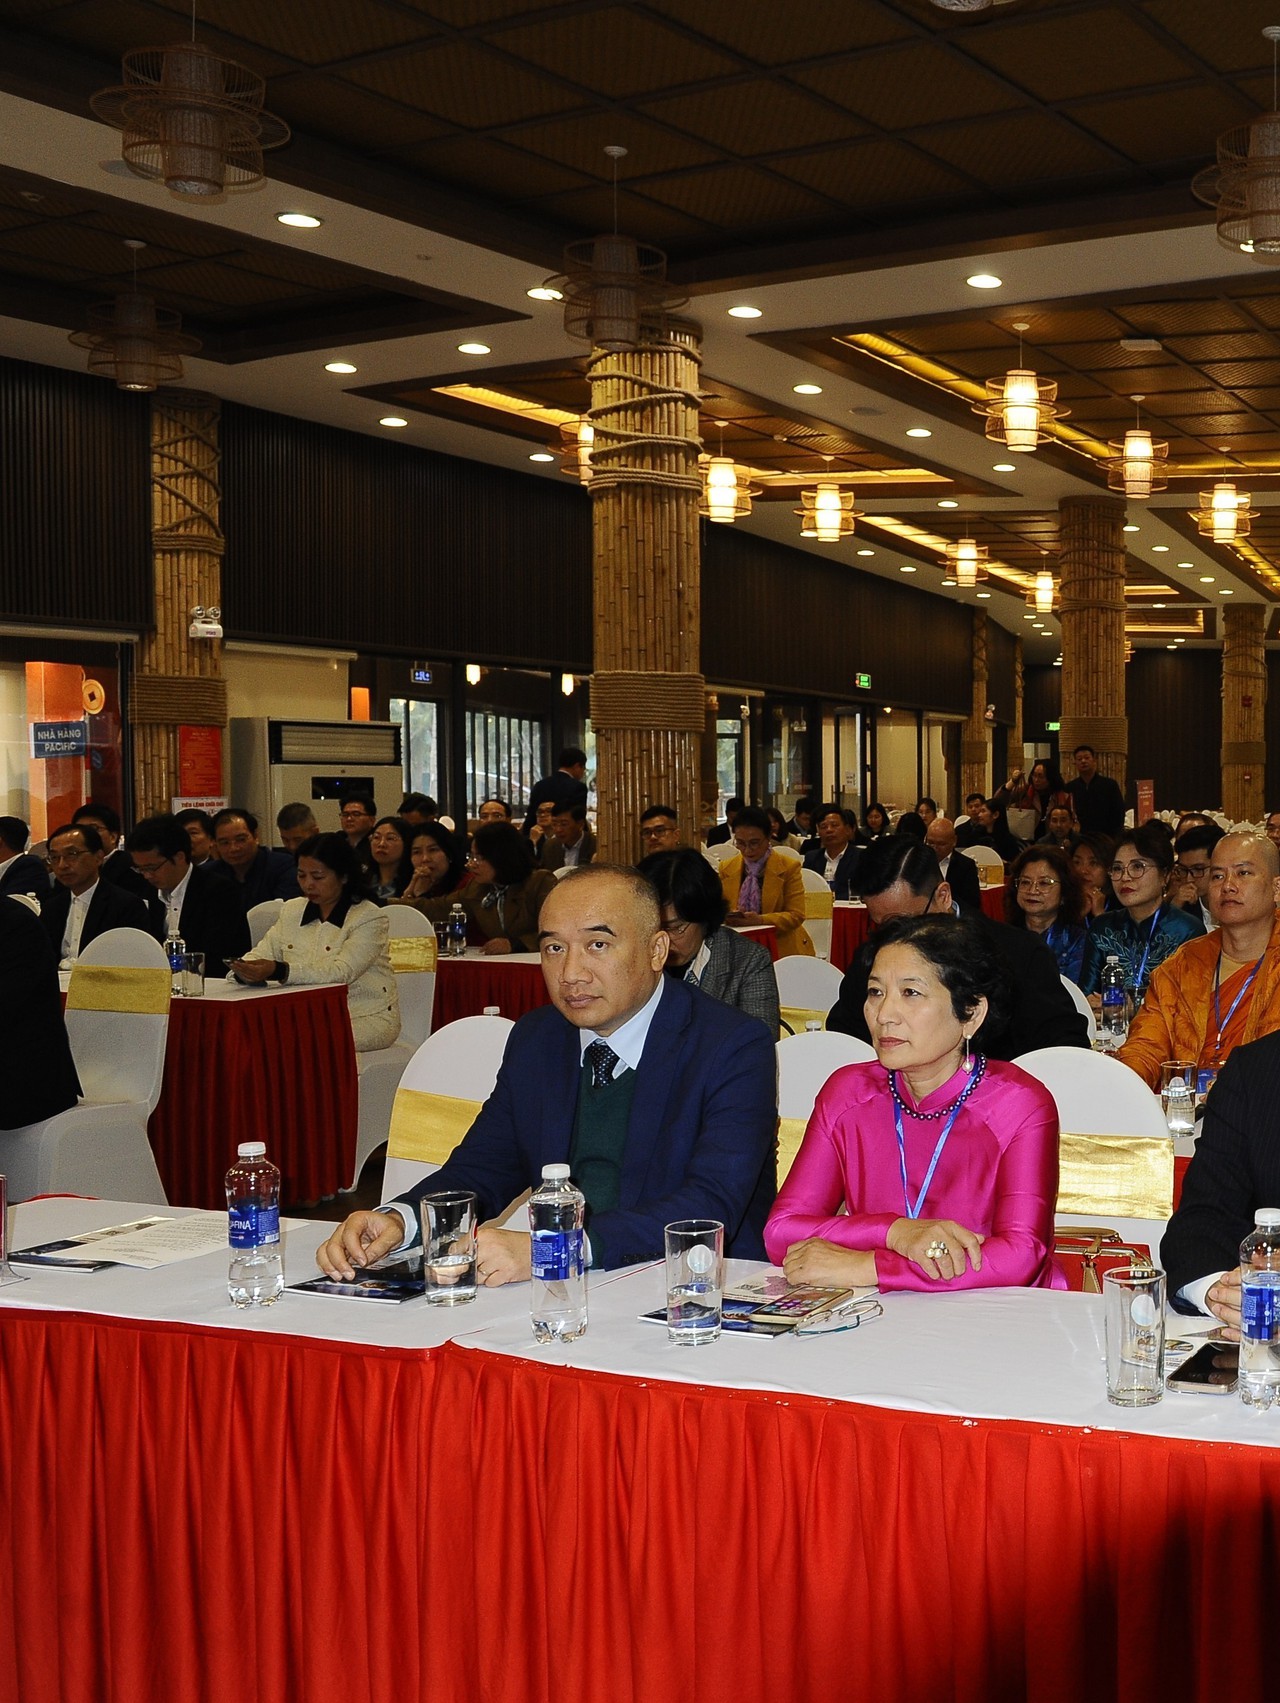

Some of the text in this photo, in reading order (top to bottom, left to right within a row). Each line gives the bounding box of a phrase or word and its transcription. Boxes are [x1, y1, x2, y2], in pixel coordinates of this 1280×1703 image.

[37, 728, 81, 740] NHÀ HÀNG
[44, 741, 77, 752] PACIFIC
